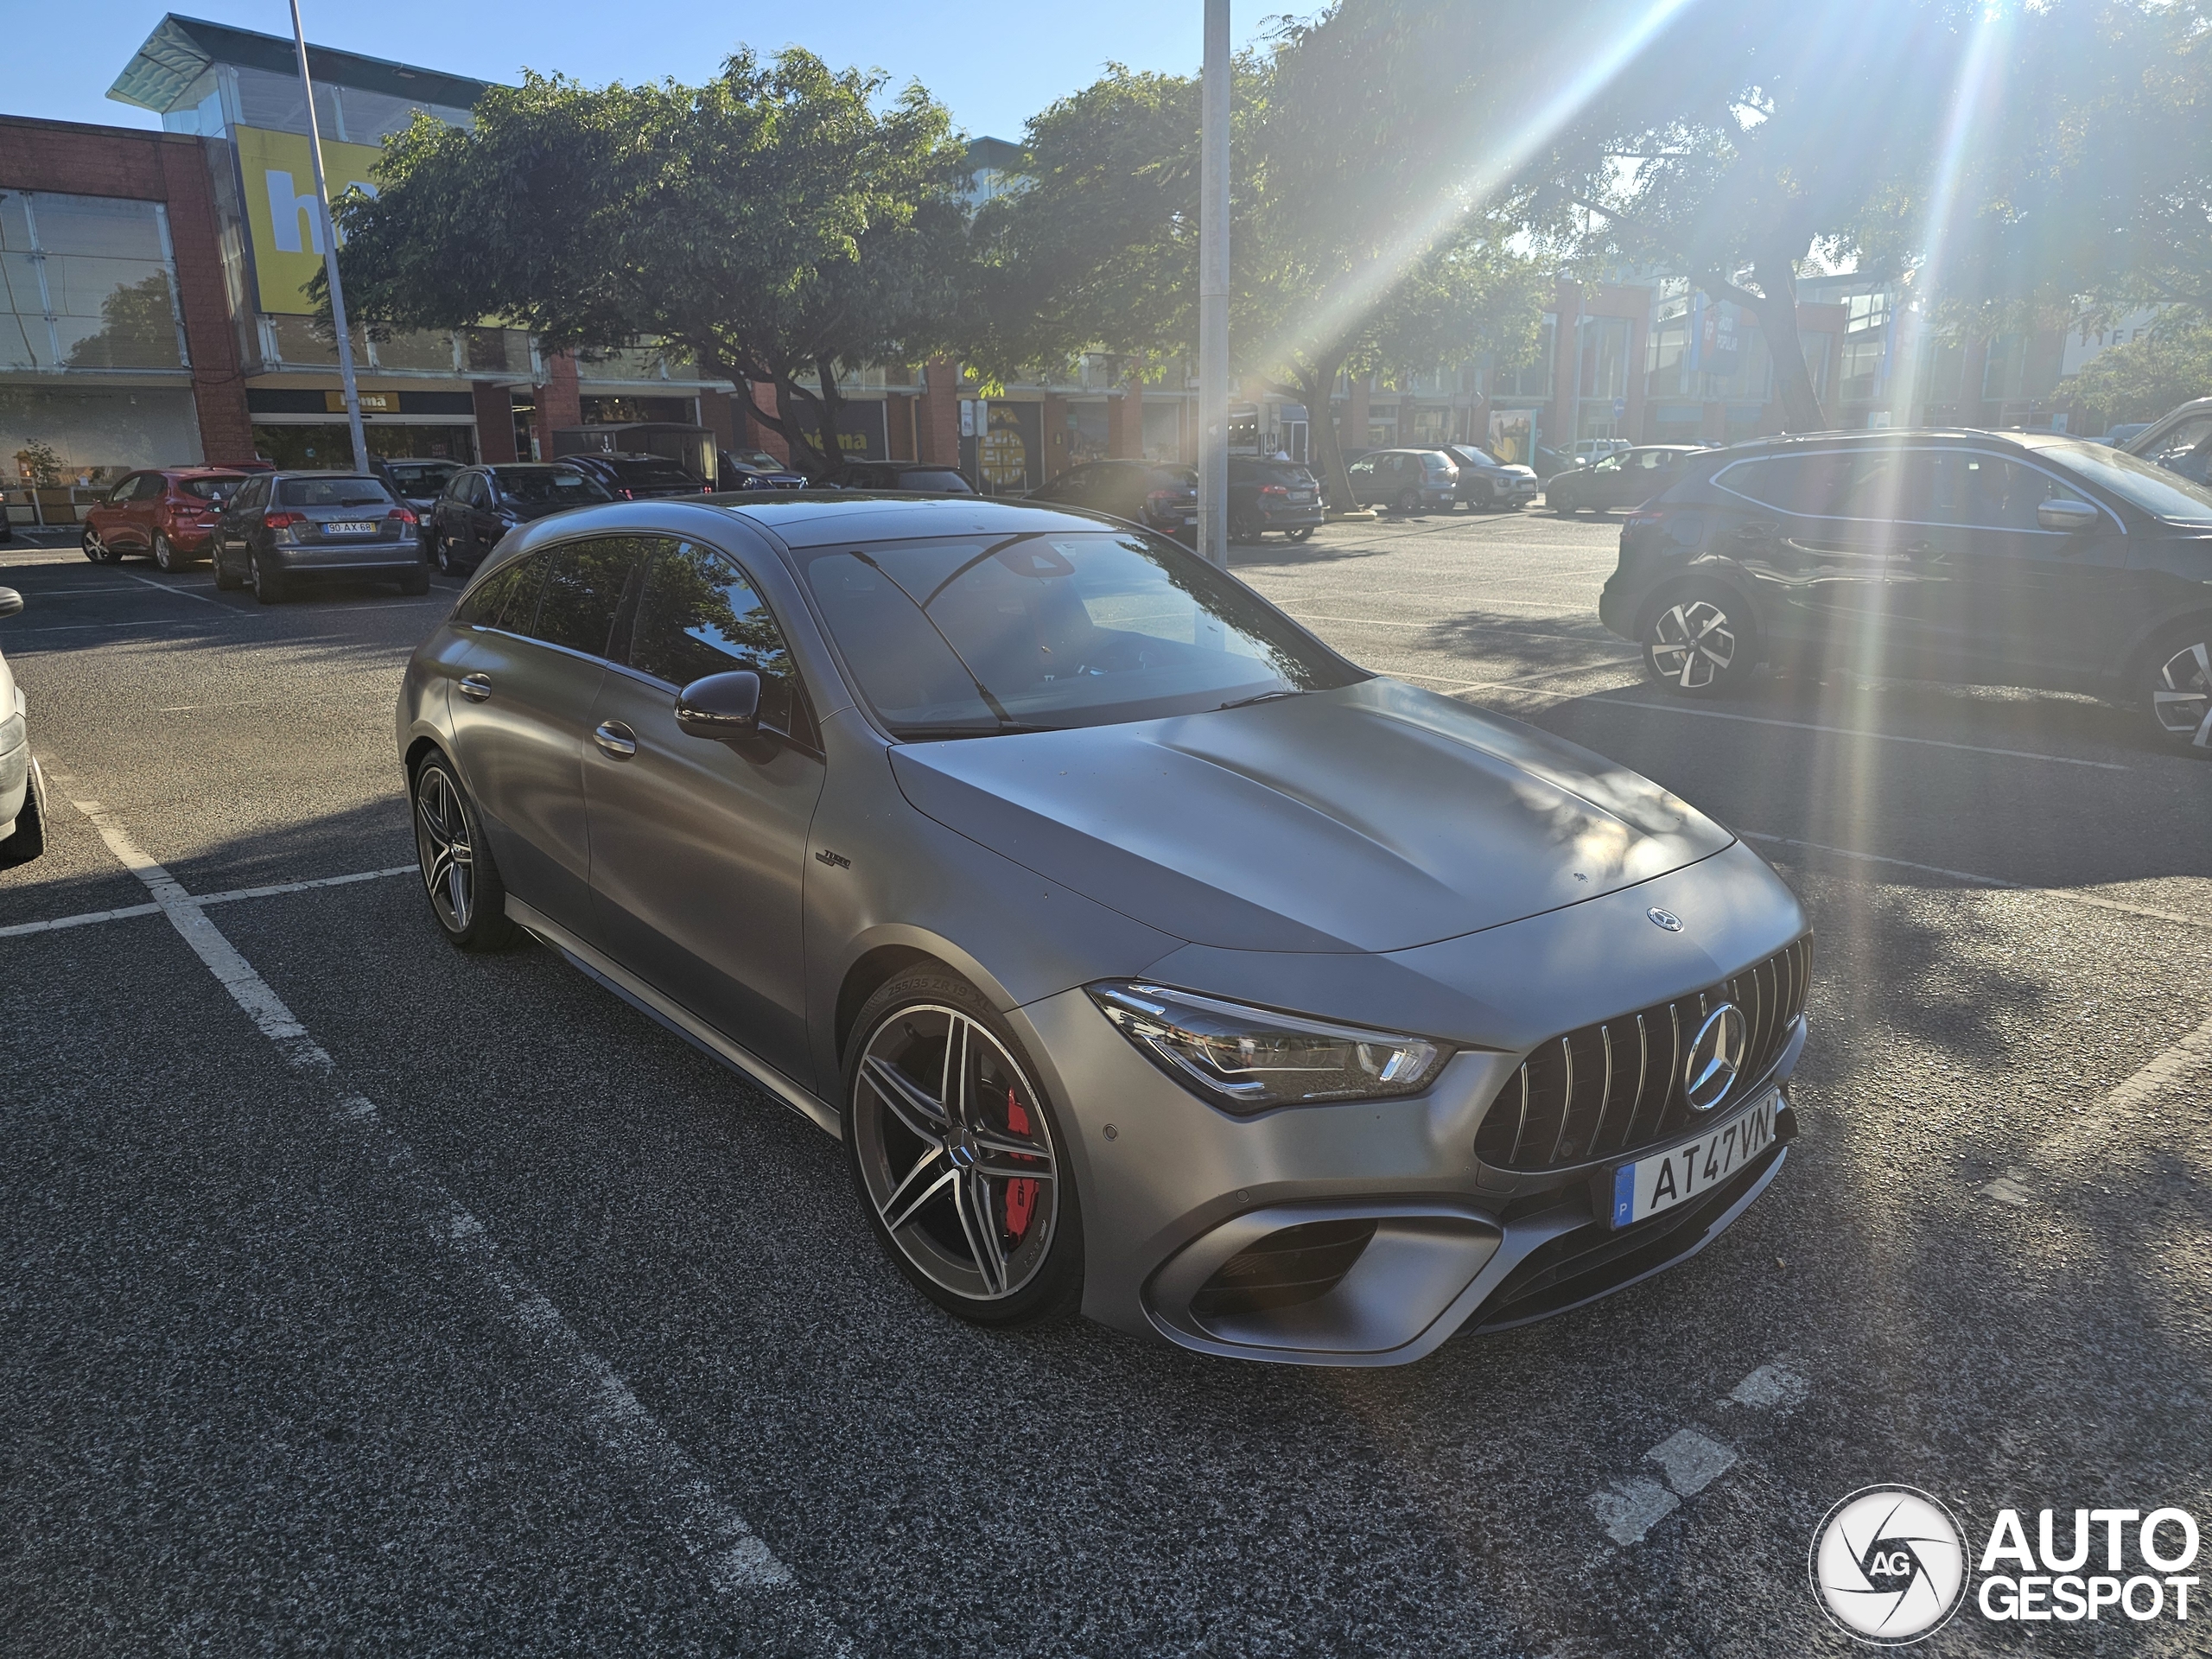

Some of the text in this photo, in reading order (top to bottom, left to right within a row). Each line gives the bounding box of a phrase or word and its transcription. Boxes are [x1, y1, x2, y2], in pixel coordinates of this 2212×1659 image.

[1716, 334, 1738, 352] POPULAR
[887, 978, 991, 1014] 255/35 ZR 19 XL
[1618, 1202, 1628, 1217] P
